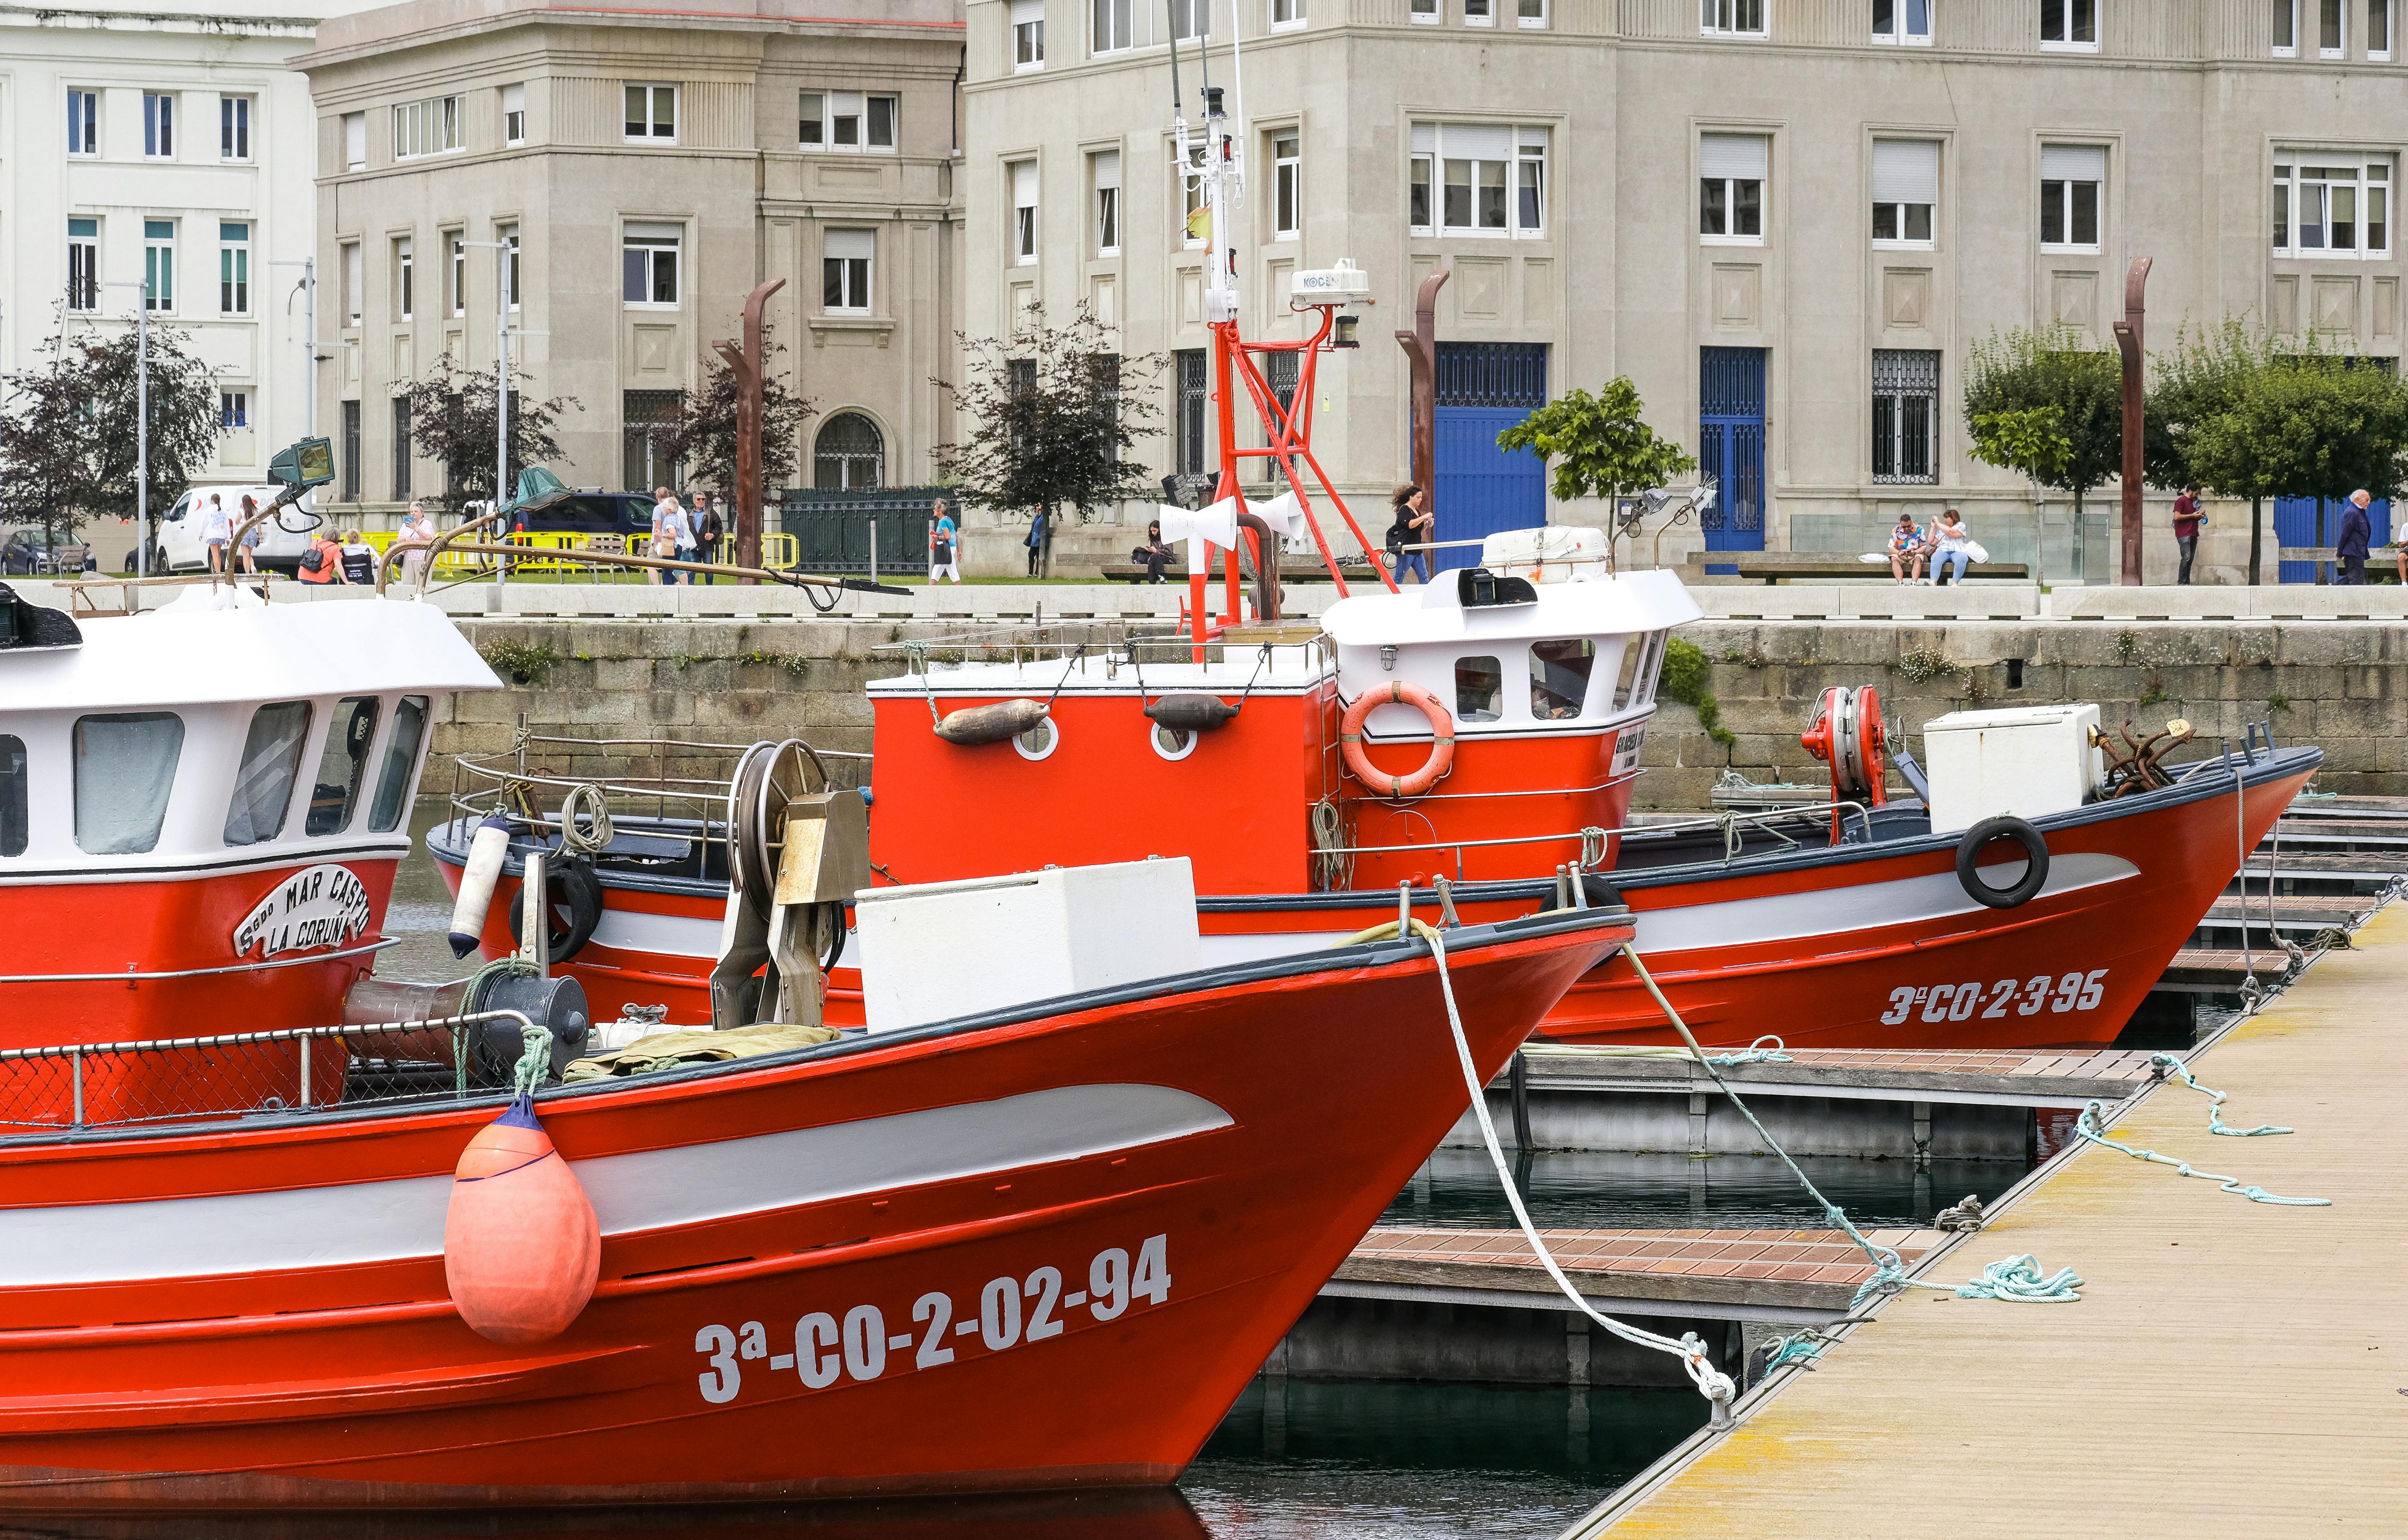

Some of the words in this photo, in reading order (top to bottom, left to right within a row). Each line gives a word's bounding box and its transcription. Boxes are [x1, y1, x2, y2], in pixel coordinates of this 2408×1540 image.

[268, 924, 289, 953] LA
[296, 910, 349, 947] CORUÑA
[286, 871, 323, 915] MAR
[329, 870, 370, 937] CASPIO
[695, 1233, 1172, 1404] 3ª-CO-2-02-94
